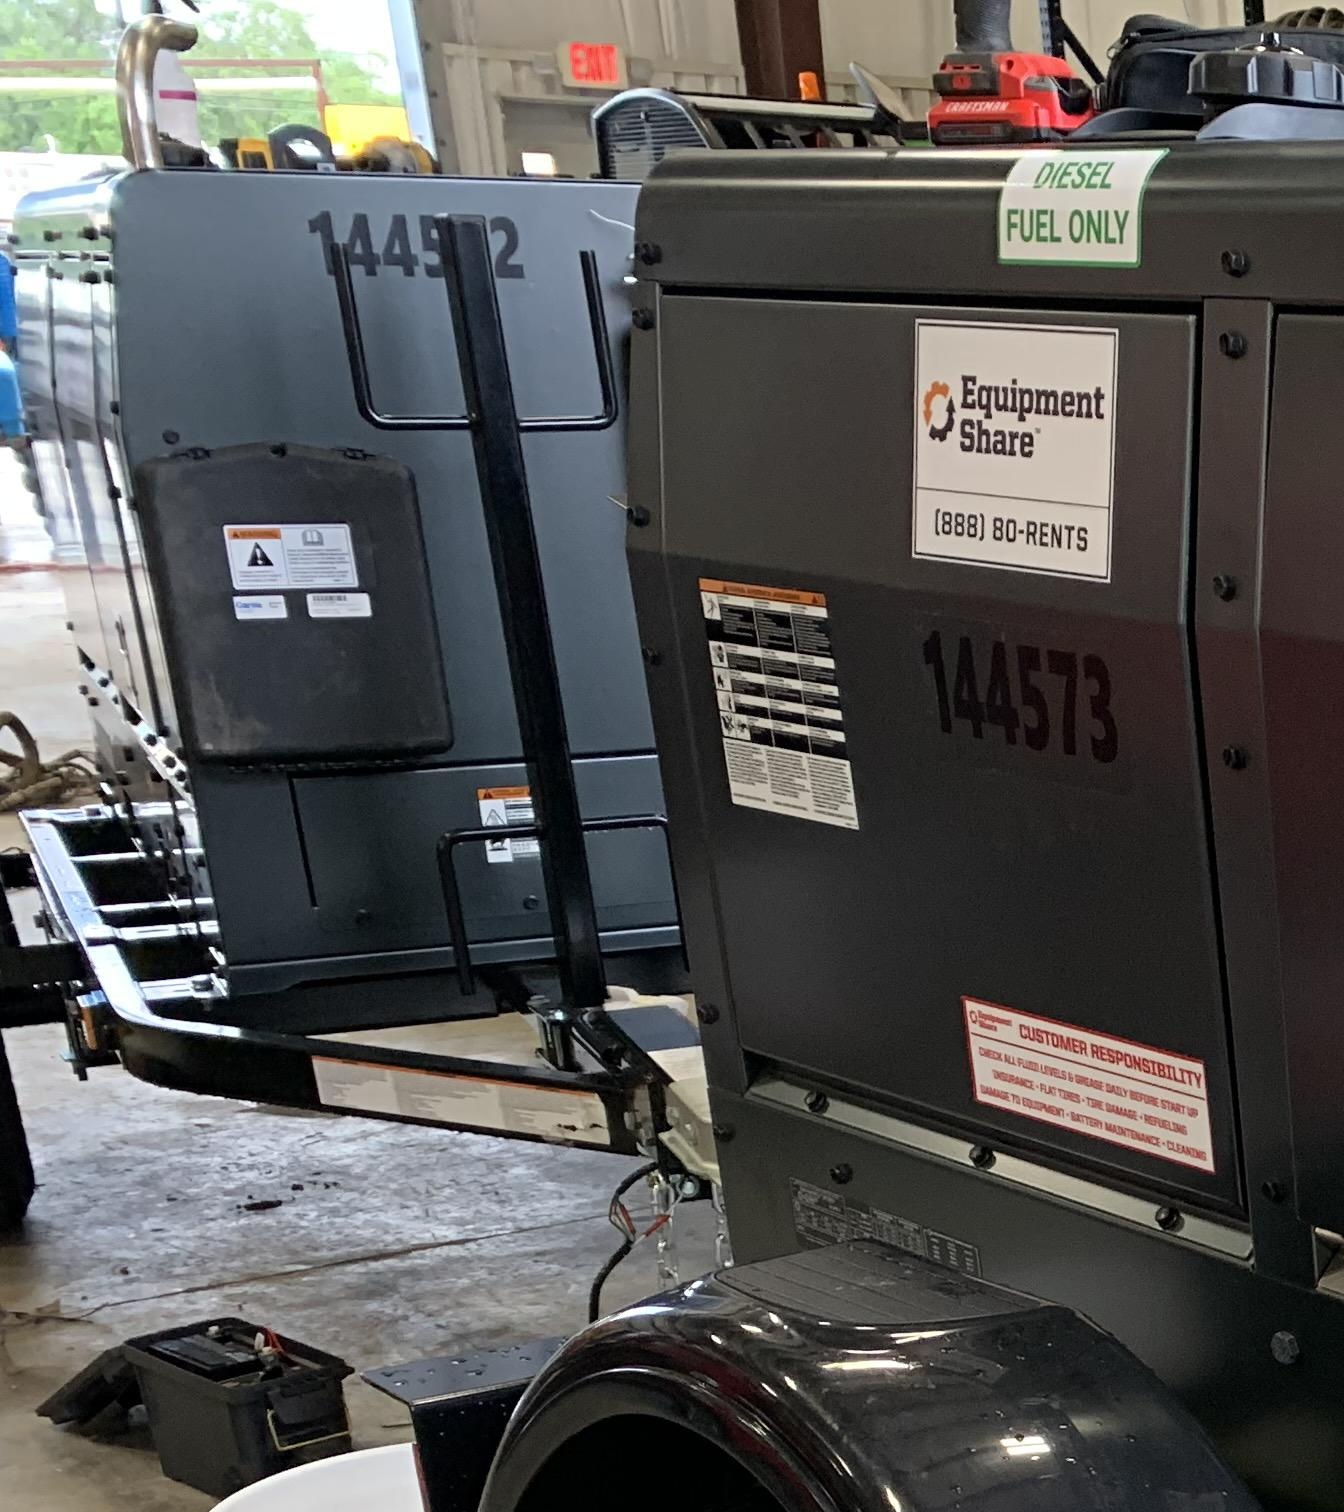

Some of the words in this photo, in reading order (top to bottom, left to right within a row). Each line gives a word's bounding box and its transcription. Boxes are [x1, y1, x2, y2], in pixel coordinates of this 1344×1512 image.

[569, 42, 618, 81] EXIT
[945, 101, 1010, 113] CRAFTSMAN
[1033, 161, 1115, 190] DIESEL
[308, 210, 526, 279] 14452
[1006, 208, 1062, 243] FUEL
[1068, 210, 1130, 244] ONLY
[960, 374, 1105, 422] Equipment
[959, 418, 1034, 458] Share
[935, 508, 985, 541] (888)
[992, 517, 1088, 552] 80-RENTS
[923, 630, 1118, 763] 144573
[1019, 1024, 1088, 1056] CUSTOMER
[1091, 1043, 1201, 1088] RESPONSIBILITY
[979, 1047, 1002, 1061] CHECK
[1004, 1054, 1016, 1066] ALL
[1040, 1064, 1067, 1080] LEVELS
[1075, 1074, 1104, 1092] GREASE
[1106, 1083, 1128, 1097] DAILY
[1129, 1090, 1159, 1108] BEFORE
[1161, 1099, 1185, 1115] START
[1187, 1107, 1198, 1118] UP
[980, 1084, 1010, 1102] DAMAGE
[1011, 1094, 1021, 1105] TO
[1022, 1098, 1065, 1119] EQUIPMENT
[1071, 1111, 1103, 1129] BATTERY
[1105, 1122, 1161, 1147] MAINTENANCE
[1166, 1141, 1207, 1160] CLEANING
[1040, 1083, 1057, 1096] FLAT
[1058, 1088, 1081, 1104] TIRES
[1086, 1097, 1104, 1111] TIRE
[1106, 1103, 1137, 1120] DAMAGE
[1144, 1114, 1188, 1136] REFUELING
